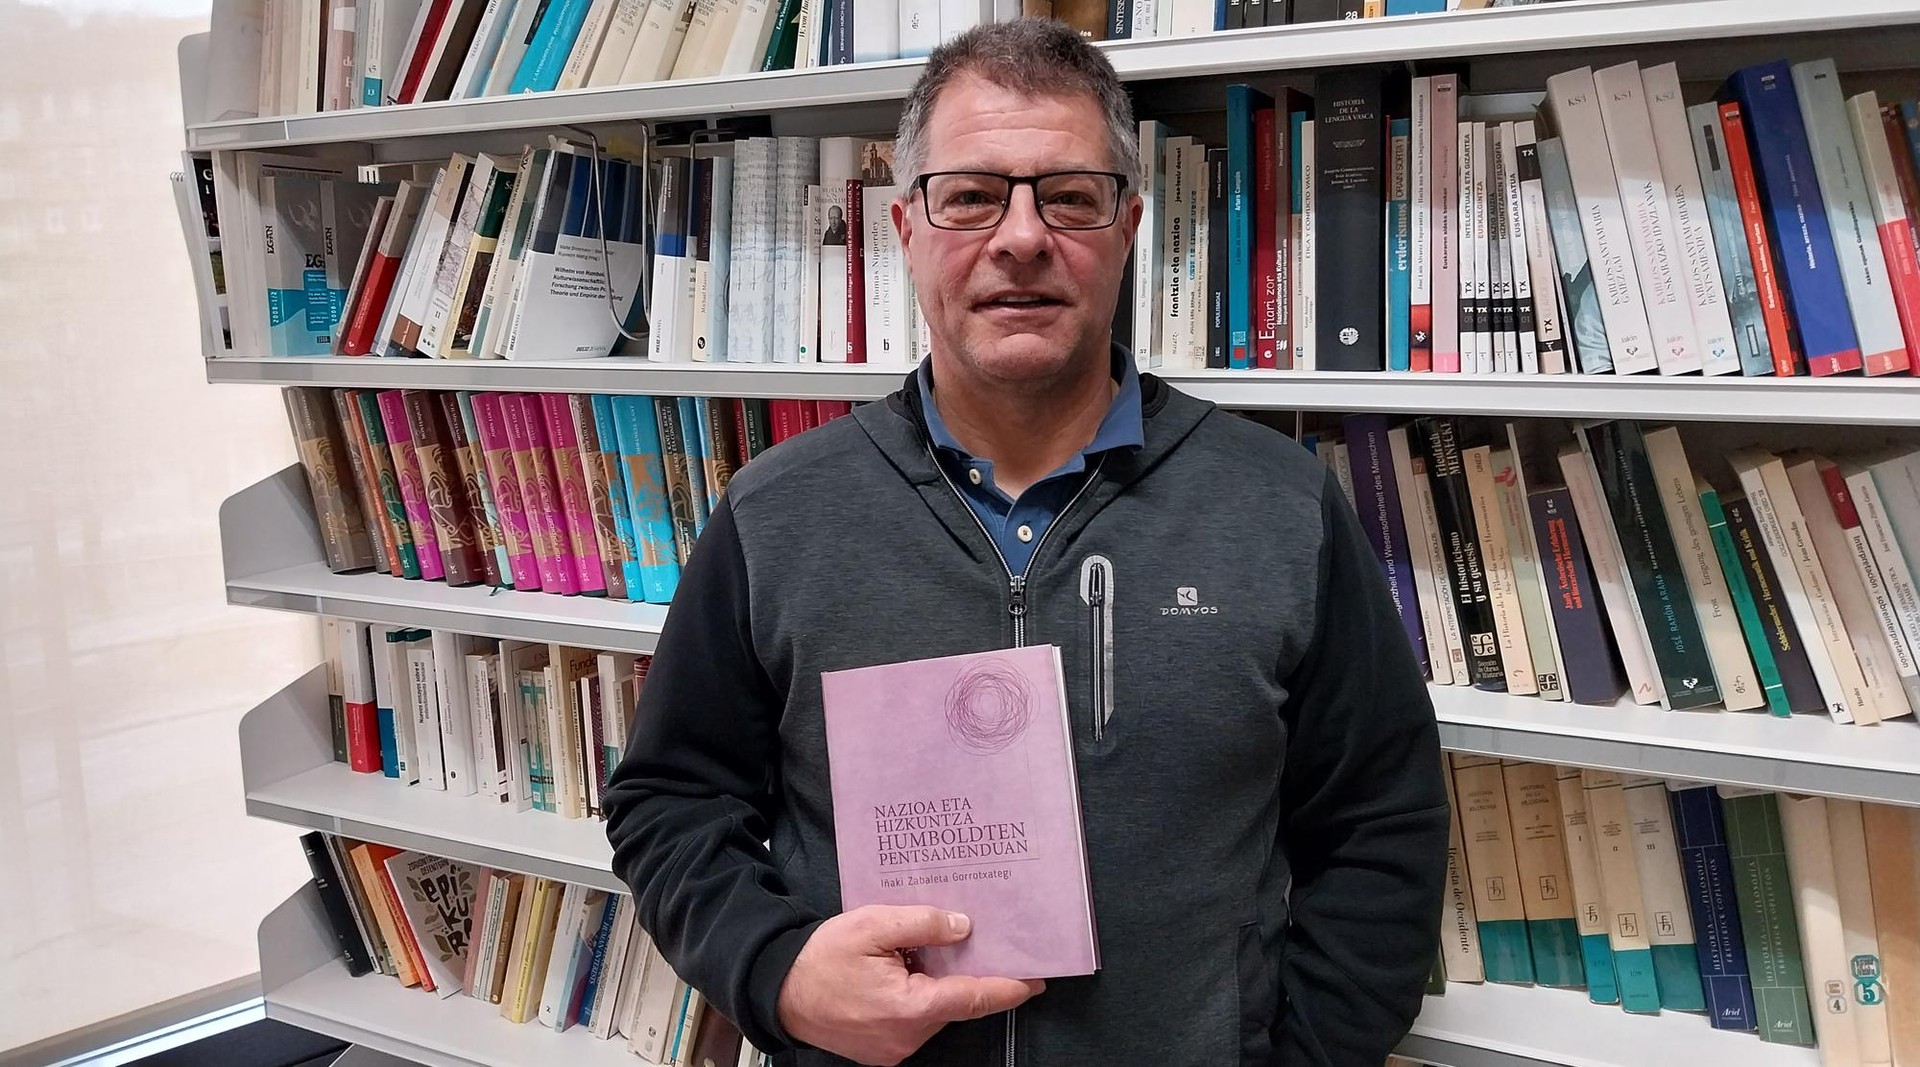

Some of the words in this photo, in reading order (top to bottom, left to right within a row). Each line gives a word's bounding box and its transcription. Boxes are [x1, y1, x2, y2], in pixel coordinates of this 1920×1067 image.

[1346, 11, 1358, 20] 28
[1396, 145, 1405, 172] SORTA
[1495, 141, 1503, 180] FILOSOFIA
[1396, 174, 1404, 198] ORAIN
[1510, 173, 1518, 199] BATUA
[1498, 182, 1507, 240] HIZKUNTZAREN
[1513, 201, 1521, 237] EUSKARA
[1643, 181, 1662, 236] IDAZLANAK
[881, 200, 889, 268] GESCHICHTE
[1172, 217, 1180, 253] nazioa
[1396, 202, 1408, 270] erderismos
[1591, 204, 1609, 265] SANTAMARIA
[1636, 201, 1655, 264] SANTAMARIA
[1673, 183, 1698, 265] SANTAMARIAREN
[266, 225, 274, 254] EGAN
[325, 227, 333, 255] EGAN
[871, 220, 880, 267] Nipperdey
[1172, 256, 1180, 273] eta
[1694, 225, 1718, 304] PENTSAMENDUA
[1804, 244, 1816, 269] Historia,
[1858, 244, 1870, 266] egunak
[1264, 275, 1275, 295] zor
[1656, 239, 1677, 303] EUSKARAZKO
[1863, 267, 1873, 285] Azken
[552, 282, 577, 290] Forschung
[882, 272, 890, 327] DEUTSCHE
[1170, 277, 1180, 317] frantzia
[1465, 281, 1472, 292] TX
[1478, 282, 1486, 293] TX
[1520, 281, 1527, 292] TX
[1606, 267, 1621, 306] KARLOS
[1650, 267, 1666, 305] KARLOS
[1691, 267, 1707, 307] KARLOS
[271, 291, 279, 323] 2008-1/2
[1258, 299, 1276, 339] Egiari
[714, 431, 723, 459] SIGMUND
[1366, 431, 1381, 473] Menschen
[1429, 432, 1447, 477] Friedrich
[1474, 452, 1484, 473] UNED
[1373, 474, 1383, 490] des
[1672, 477, 1686, 504] Lebens
[1375, 491, 1394, 558] Wesensoffenheit
[1790, 521, 1805, 547] Grondin
[1692, 537, 1700, 551] des
[1800, 547, 1812, 563] Jean
[1385, 559, 1395, 574] und
[1450, 531, 1470, 592] historicismo
[1464, 542, 1481, 579] génesis
[1694, 552, 1712, 586] Einigung
[1461, 593, 1472, 604] El
[1473, 580, 1482, 593] su
[1654, 574, 1669, 601] ARANA
[1160, 605, 1218, 616] DOMYOS
[1710, 598, 1721, 618] Frost
[1852, 535, 1877, 589] Interpretación
[1876, 595, 1910, 669] sobreinterpretación
[1664, 604, 1679, 632] RAMÓN
[1672, 635, 1685, 653] JOSÉ
[1852, 687, 1864, 707] Herder
[874, 799, 938, 819] NAZIOA
[942, 796, 972, 813] ETA
[875, 812, 975, 835] HIZKUNTZA
[877, 822, 1026, 851] HUMBOLDTEN
[878, 840, 1029, 866] PENTSAMENDUAN
[1448, 847, 1460, 885] Revista
[880, 875, 905, 889] Iñaki
[907, 872, 949, 886] Zabaleta
[952, 868, 1013, 884] Gorrotxategi
[1695, 852, 1709, 904] FILOSOFÍA
[1710, 858, 1724, 910] COPLESTON
[1749, 861, 1763, 913] FILOSOFÍA
[1453, 888, 1464, 900] de
[1456, 902, 1470, 953] Occidente
[1719, 914, 1733, 963] FREDERICK
[1707, 923, 1721, 970] HISTORIA
[1761, 934, 1774, 982] HISTORIA
[1773, 924, 1786, 975] FREDERICK
[1833, 1000, 1841, 1011] 4
[1862, 983, 1875, 1002] 5
[1722, 1008, 1741, 1016] Ariel
[1774, 1020, 1794, 1028] Ariel
